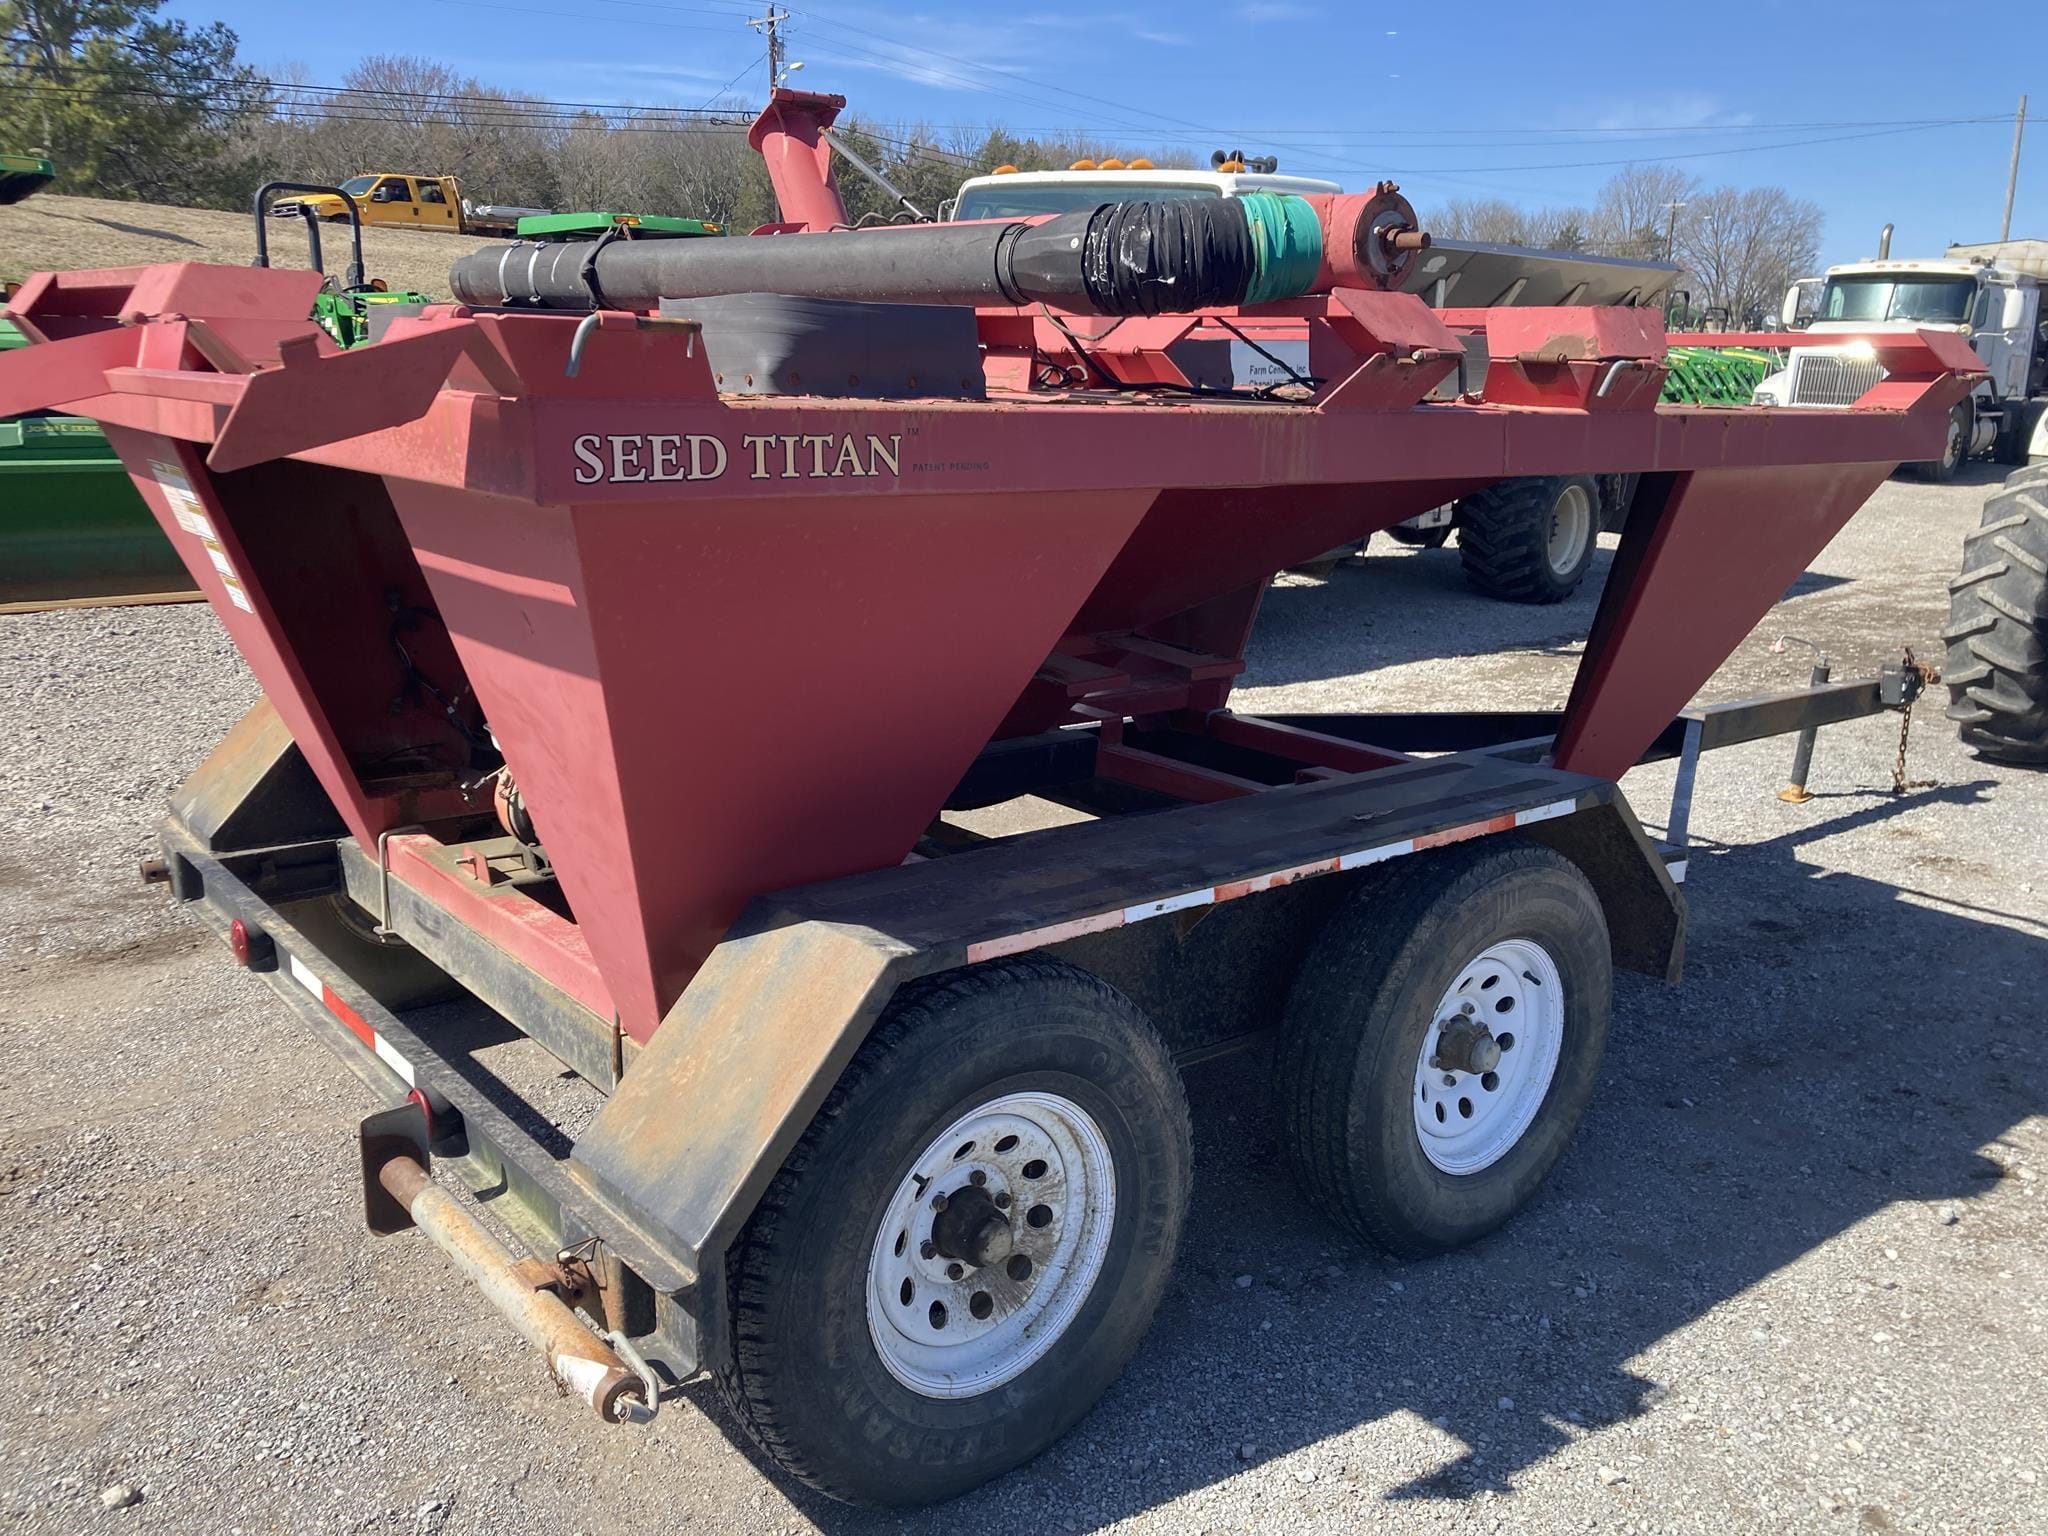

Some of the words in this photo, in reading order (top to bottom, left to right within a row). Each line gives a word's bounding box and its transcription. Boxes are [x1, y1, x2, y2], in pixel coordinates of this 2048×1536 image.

[1250, 365, 1267, 375] Farm
[573, 434, 728, 484] SEED
[743, 433, 902, 480] TITAN
[912, 463, 946, 473] PATENT
[950, 462, 990, 472] PENDING
